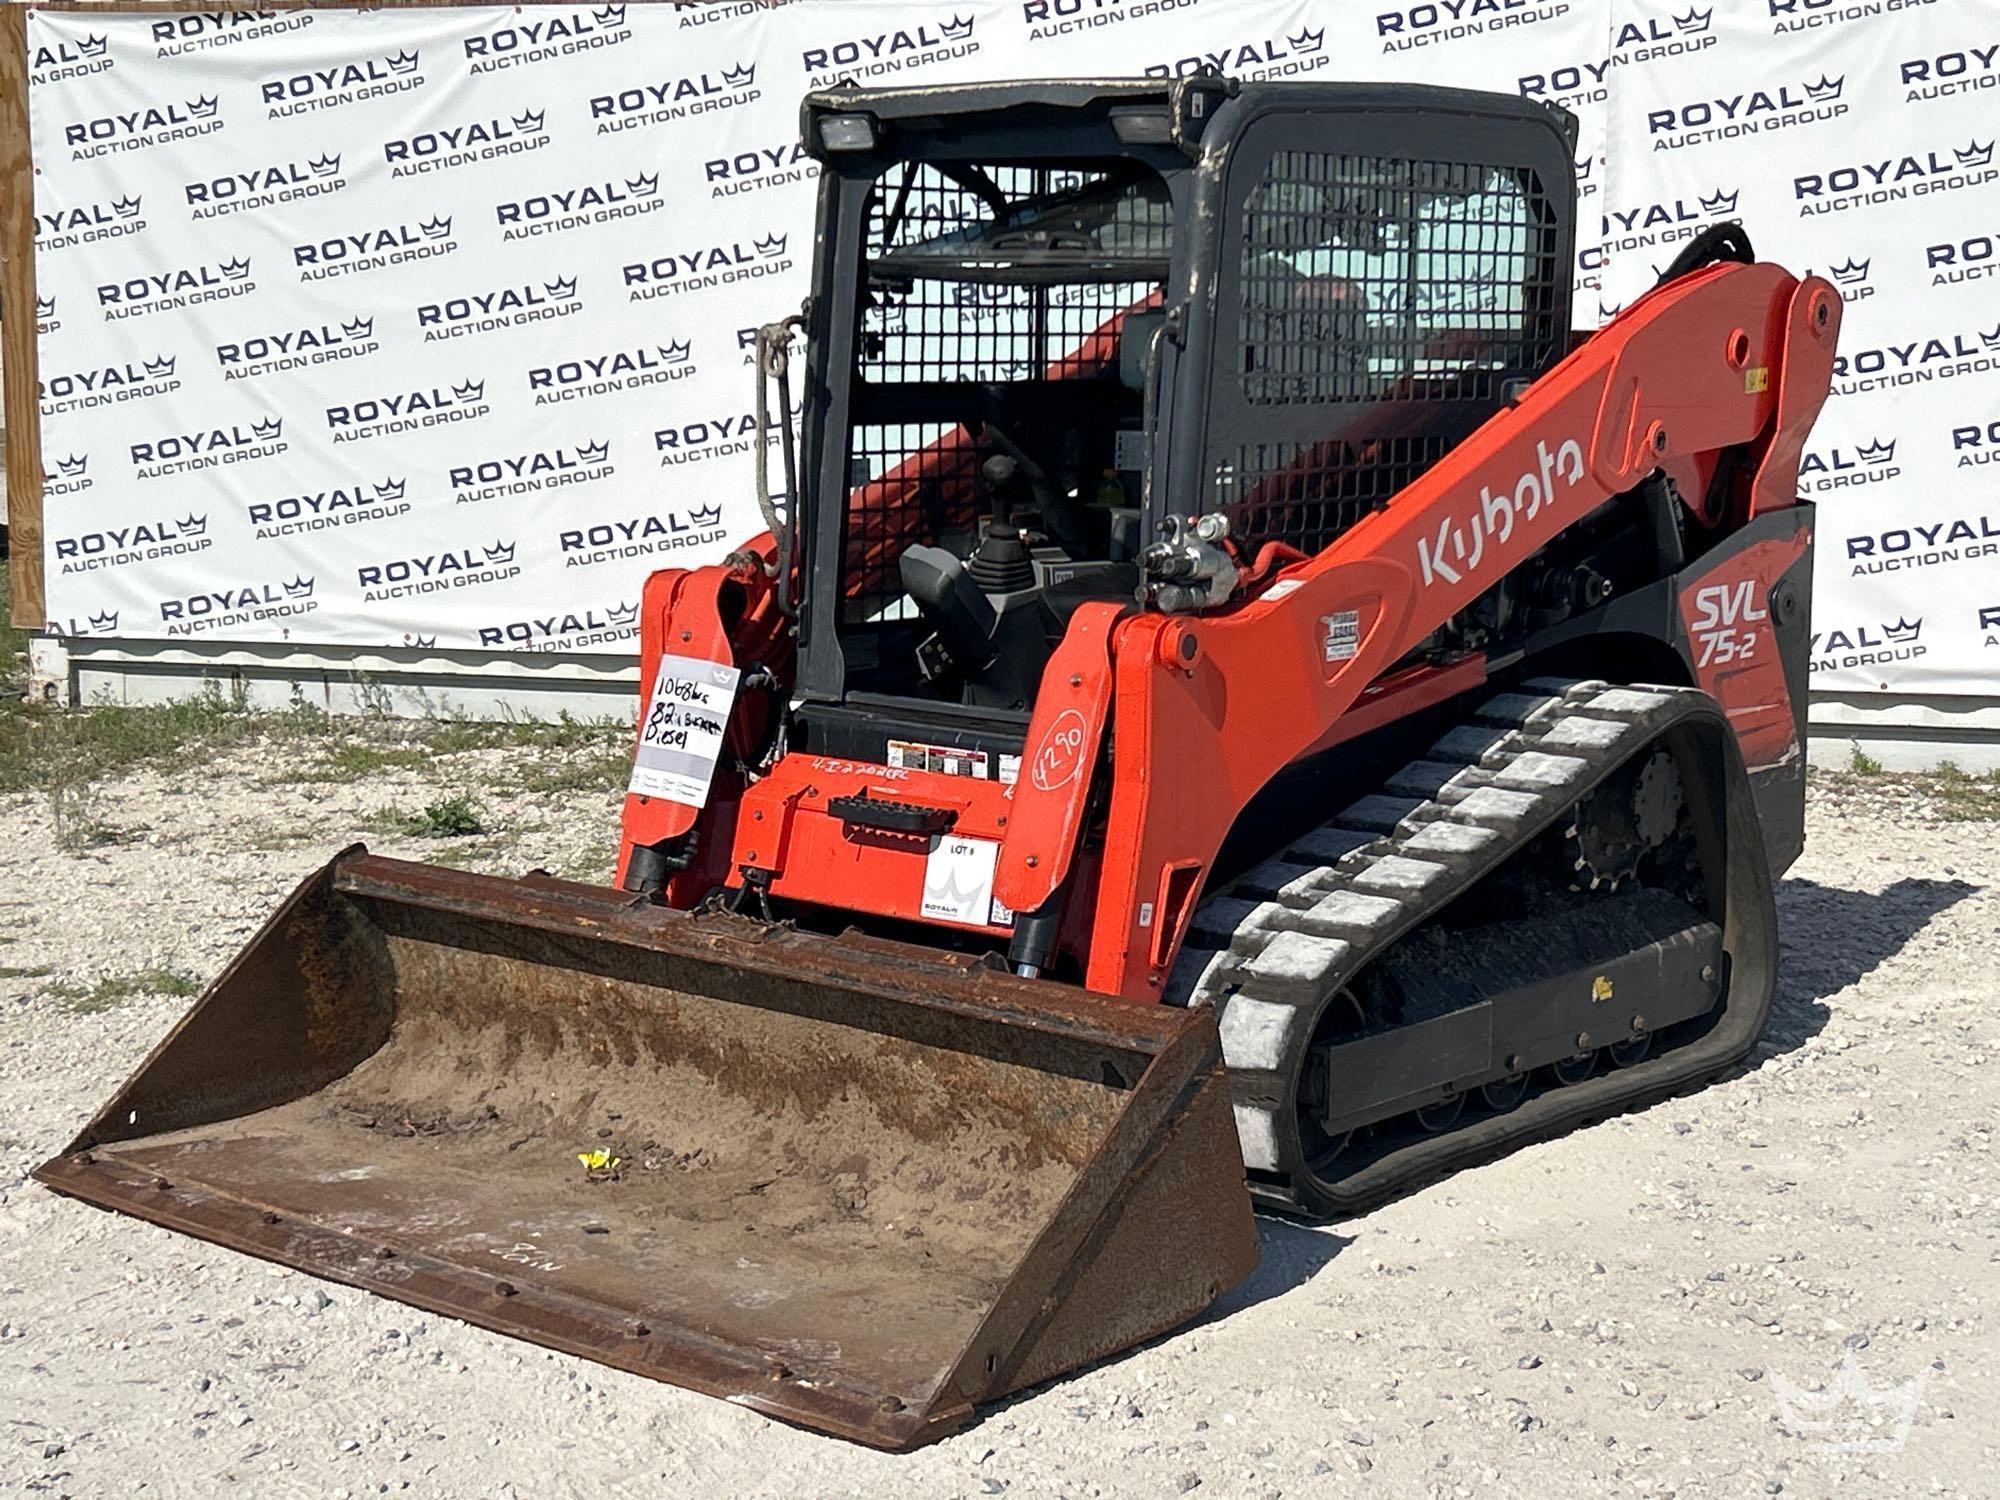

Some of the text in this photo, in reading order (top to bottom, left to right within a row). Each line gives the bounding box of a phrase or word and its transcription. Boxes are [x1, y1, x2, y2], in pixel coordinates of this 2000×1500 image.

[679, 2, 769, 29] AUCTION
[1030, 10, 1125, 41] AUCTION
[1383, 4, 1569, 54] AUCTION GROUP
[1774, 2, 1881, 34] AUCTION
[157, 15, 313, 59] AUCTION GROUP
[464, 15, 593, 58] ROYAL
[470, 30, 632, 75] AUCTION GROUP
[803, 26, 940, 72] ROYAL
[803, 26, 940, 72] ROYAL
[907, 42, 979, 68] GROUP
[1635, 36, 1717, 62] GROUP
[50, 59, 114, 82] GROUP
[262, 61, 388, 103] ROYAL
[1253, 56, 1329, 82] GROUP
[269, 76, 424, 120] AUCTION GROUP
[590, 74, 722, 118] ROYAL
[1906, 75, 2000, 103] AUCTIO
[65, 105, 188, 146] ROYAL
[597, 90, 761, 135] AUCTION GROUP
[1648, 87, 1803, 134] ROYAL
[1654, 104, 1848, 151] AUCTION GROUP
[73, 120, 223, 161] AUCTION GROUP
[385, 120, 512, 162] ROYAL
[392, 136, 550, 179] AUCTION GROUP
[185, 164, 309, 205] ROYAL
[712, 170, 801, 198] AUCTION
[1794, 152, 1953, 199] ROYAL
[1800, 170, 1998, 217] AUCTION GROUP
[192, 179, 346, 220] AUCTION GROUP
[497, 183, 626, 225] ROYAL
[1602, 201, 1699, 237] YAL
[35, 205, 113, 236] YAL
[83, 221, 146, 243] GROUP
[504, 199, 664, 241] AUCTION GROUP
[294, 226, 420, 266] ROYAL
[301, 242, 457, 282] AUCTION GROUP
[623, 244, 754, 286] ROYAL
[97, 267, 220, 306] ROYAL
[630, 260, 792, 302] AUCTION GROUP
[105, 283, 255, 321] AUCTION GROUP
[418, 286, 545, 326] ROYAL
[424, 302, 582, 342] AUCTION GROUP
[217, 326, 342, 365] ROYAL
[225, 343, 379, 381] AUCTION GROUP
[529, 349, 658, 390] ROYAL
[536, 366, 696, 405] AUCTION GROUP
[1829, 369, 1932, 396] AUCTION
[116, 381, 180, 401] GROUP
[326, 389, 453, 428] ROYAL
[334, 405, 489, 443] AUCTION GROUP
[131, 427, 252, 464] ROYAL
[138, 443, 288, 479] AUCTION GROUP
[661, 441, 748, 467] AUCTION
[450, 450, 577, 488] ROYAL
[456, 466, 614, 504] AUCTION GROUP
[1817, 467, 1901, 491] GROUP
[248, 487, 374, 524] ROYAL
[256, 504, 411, 540] AUCTION GROUP
[1417, 439, 1584, 587] Kubota
[56, 523, 177, 559] ROYAL
[560, 513, 689, 552] ROYAL
[566, 530, 726, 567] AUCTION GROUP
[1847, 516, 2000, 559] ROYAL
[62, 539, 212, 574] AUCTION GROUP
[358, 550, 484, 587] ROYAL
[1852, 549, 1959, 577] AUCTION
[160, 585, 282, 621] ROYAL
[365, 567, 520, 602] AUCTION GROUP
[168, 602, 317, 635] AUCTION GROUP
[1691, 580, 1767, 632] SVL
[478, 611, 606, 647] ROYAL
[1698, 628, 1756, 668] 75-2
[1844, 646, 1927, 667] GROUP
[950, 845, 968, 855] LOT
